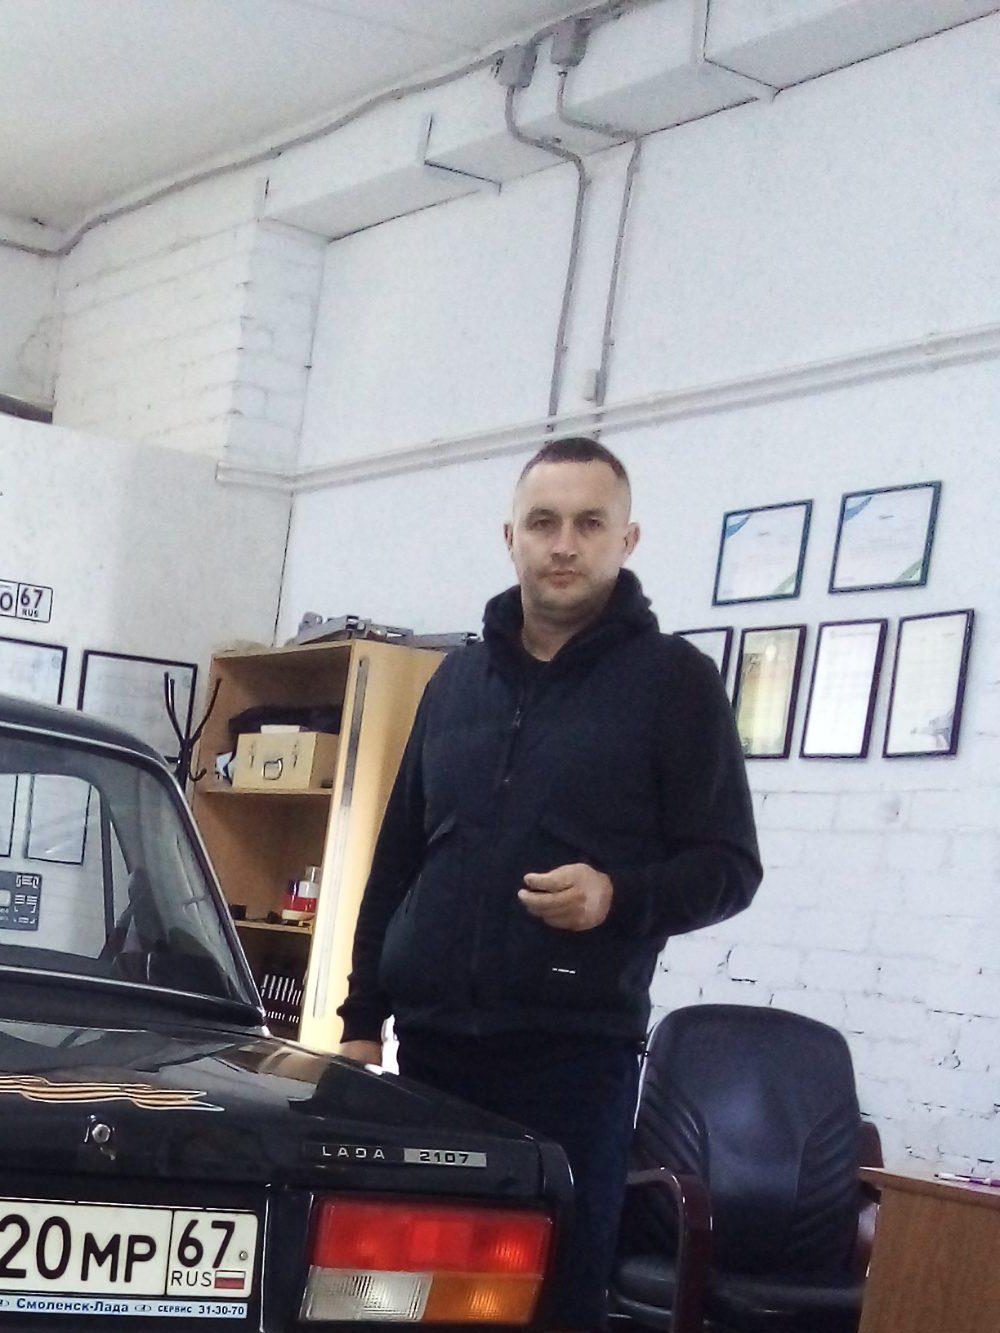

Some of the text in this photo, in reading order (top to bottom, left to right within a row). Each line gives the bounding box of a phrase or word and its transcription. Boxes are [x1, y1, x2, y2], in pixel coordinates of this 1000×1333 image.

[20, 587, 43, 609] 67
[322, 1145, 470, 1164] LADA 2107
[176, 1218, 236, 1269] 67
[170, 1270, 214, 1288] RUS
[198, 1304, 245, 1316] 31-30-70
